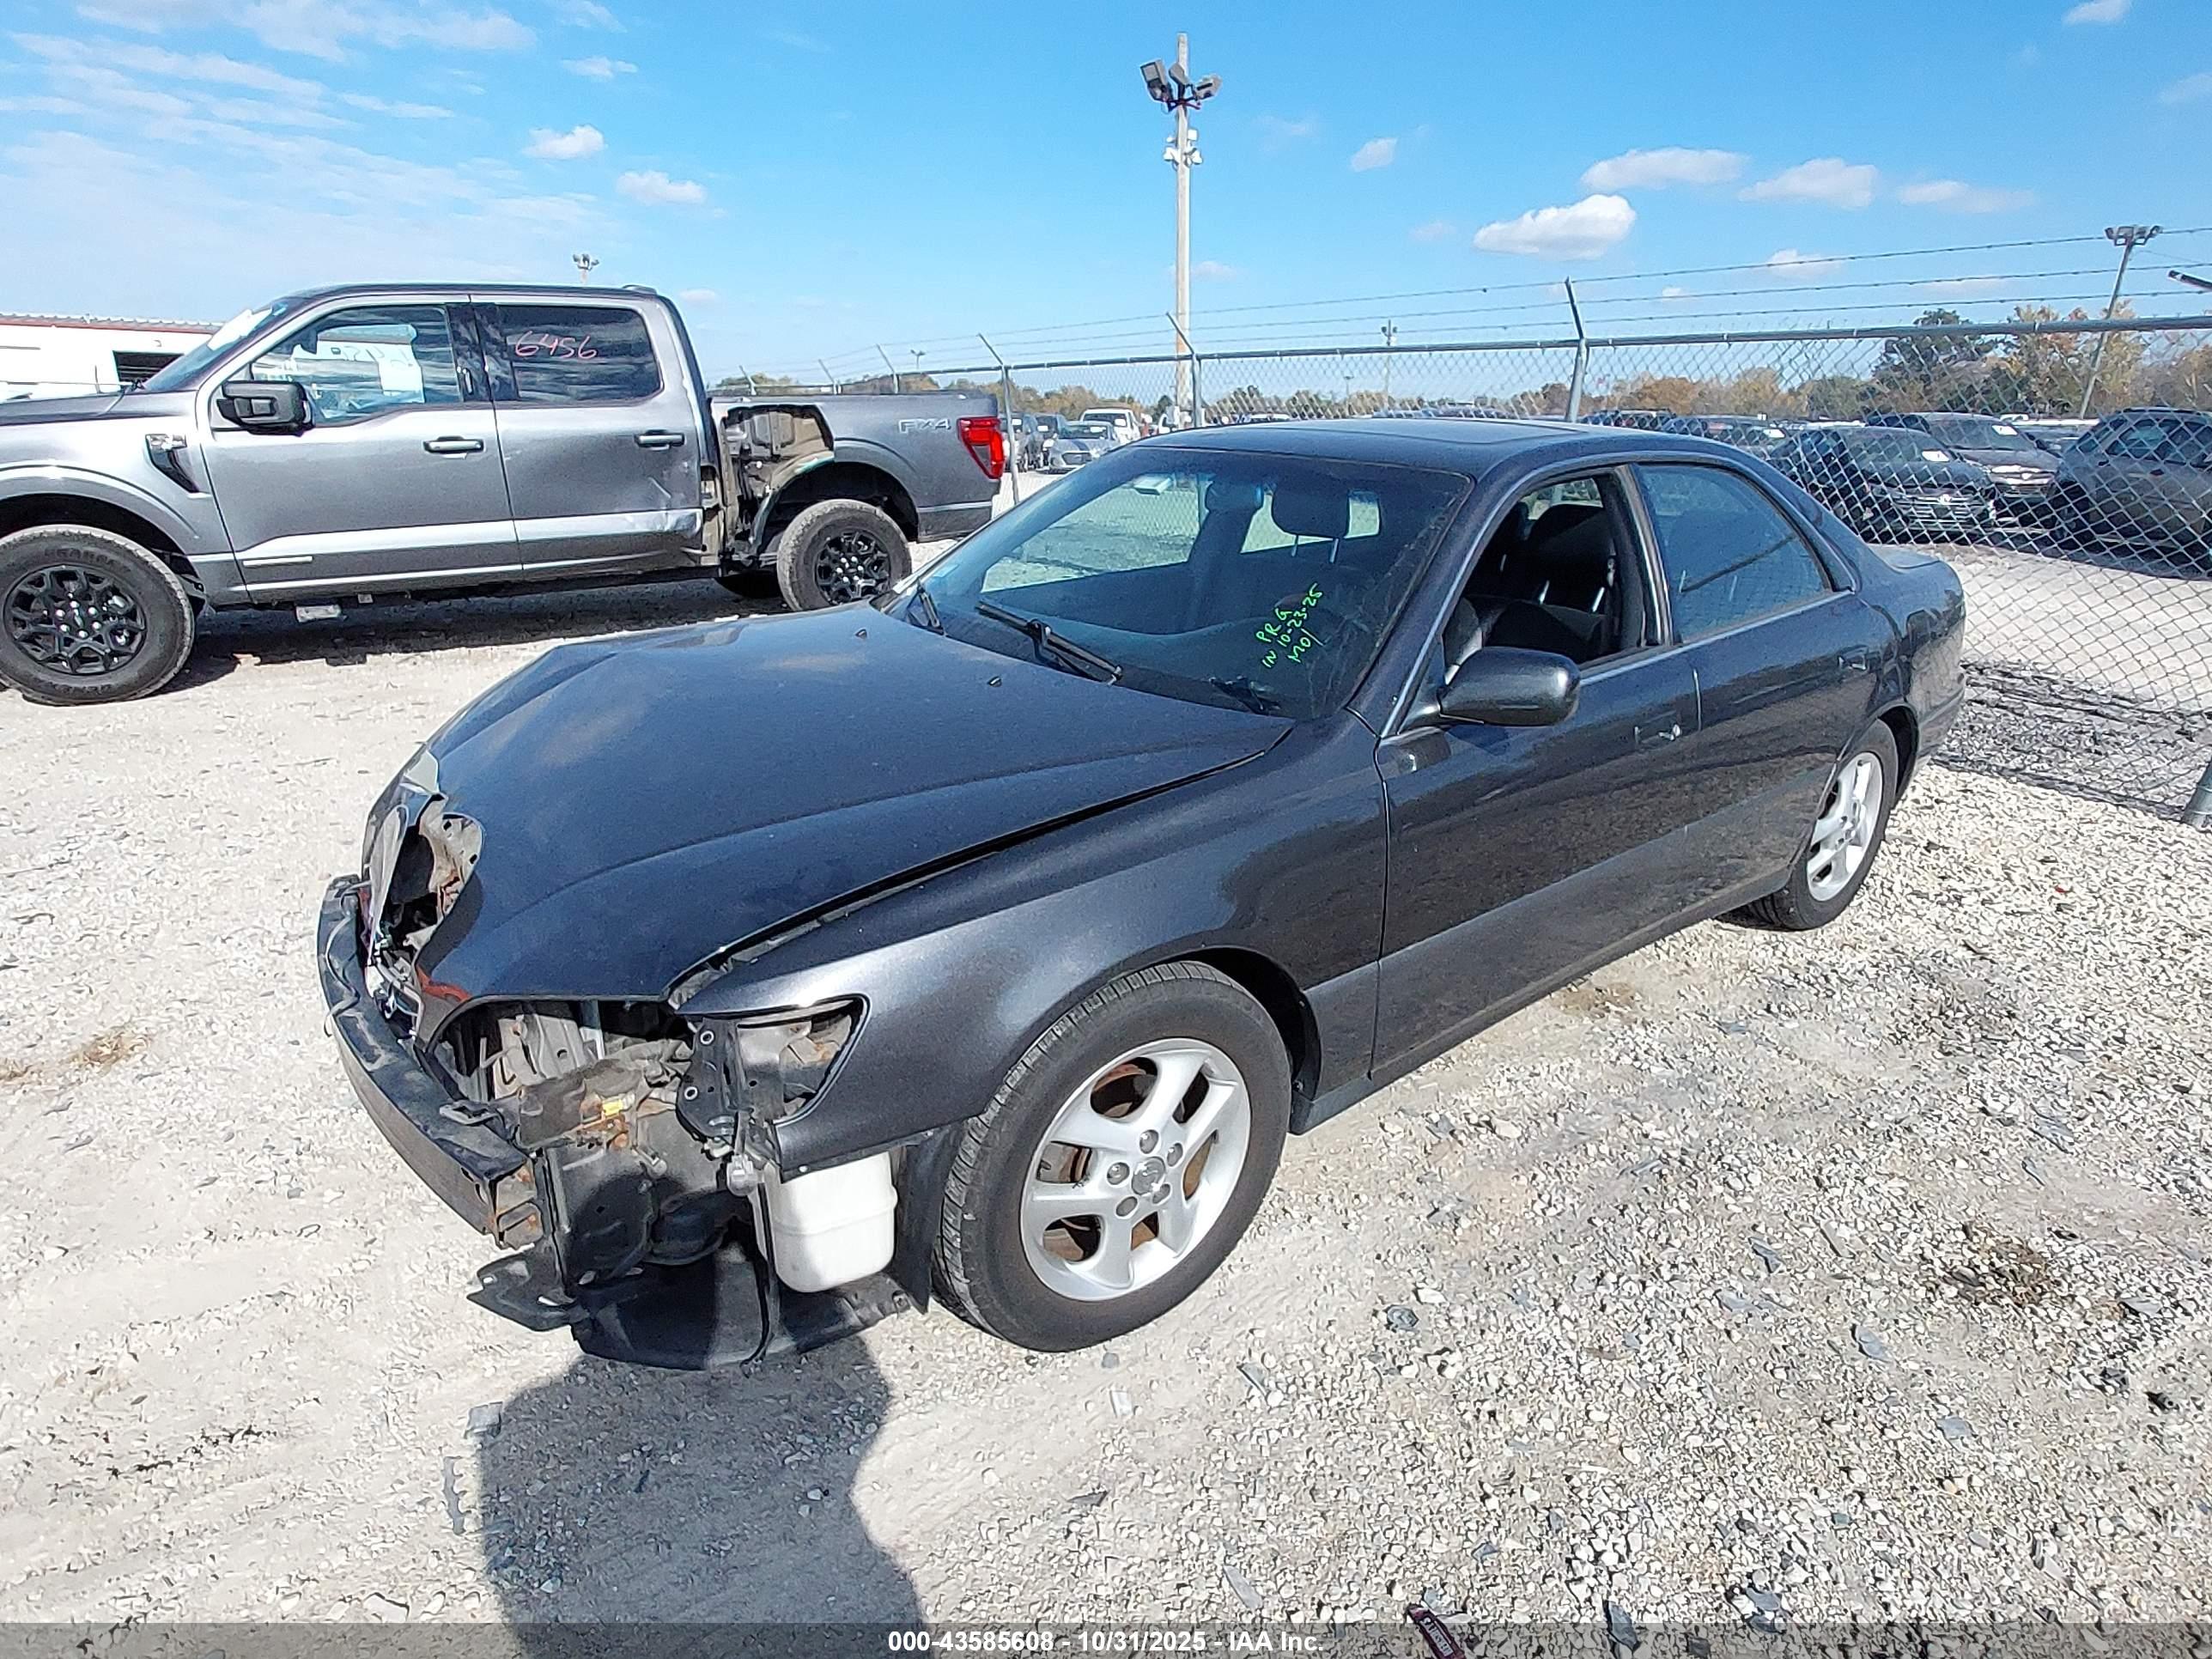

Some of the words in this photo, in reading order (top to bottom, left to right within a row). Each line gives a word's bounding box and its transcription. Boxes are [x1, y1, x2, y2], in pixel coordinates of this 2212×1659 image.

[515, 330, 598, 359] 6456
[898, 418, 951, 434] FX4
[1261, 650, 1278, 669] IN
